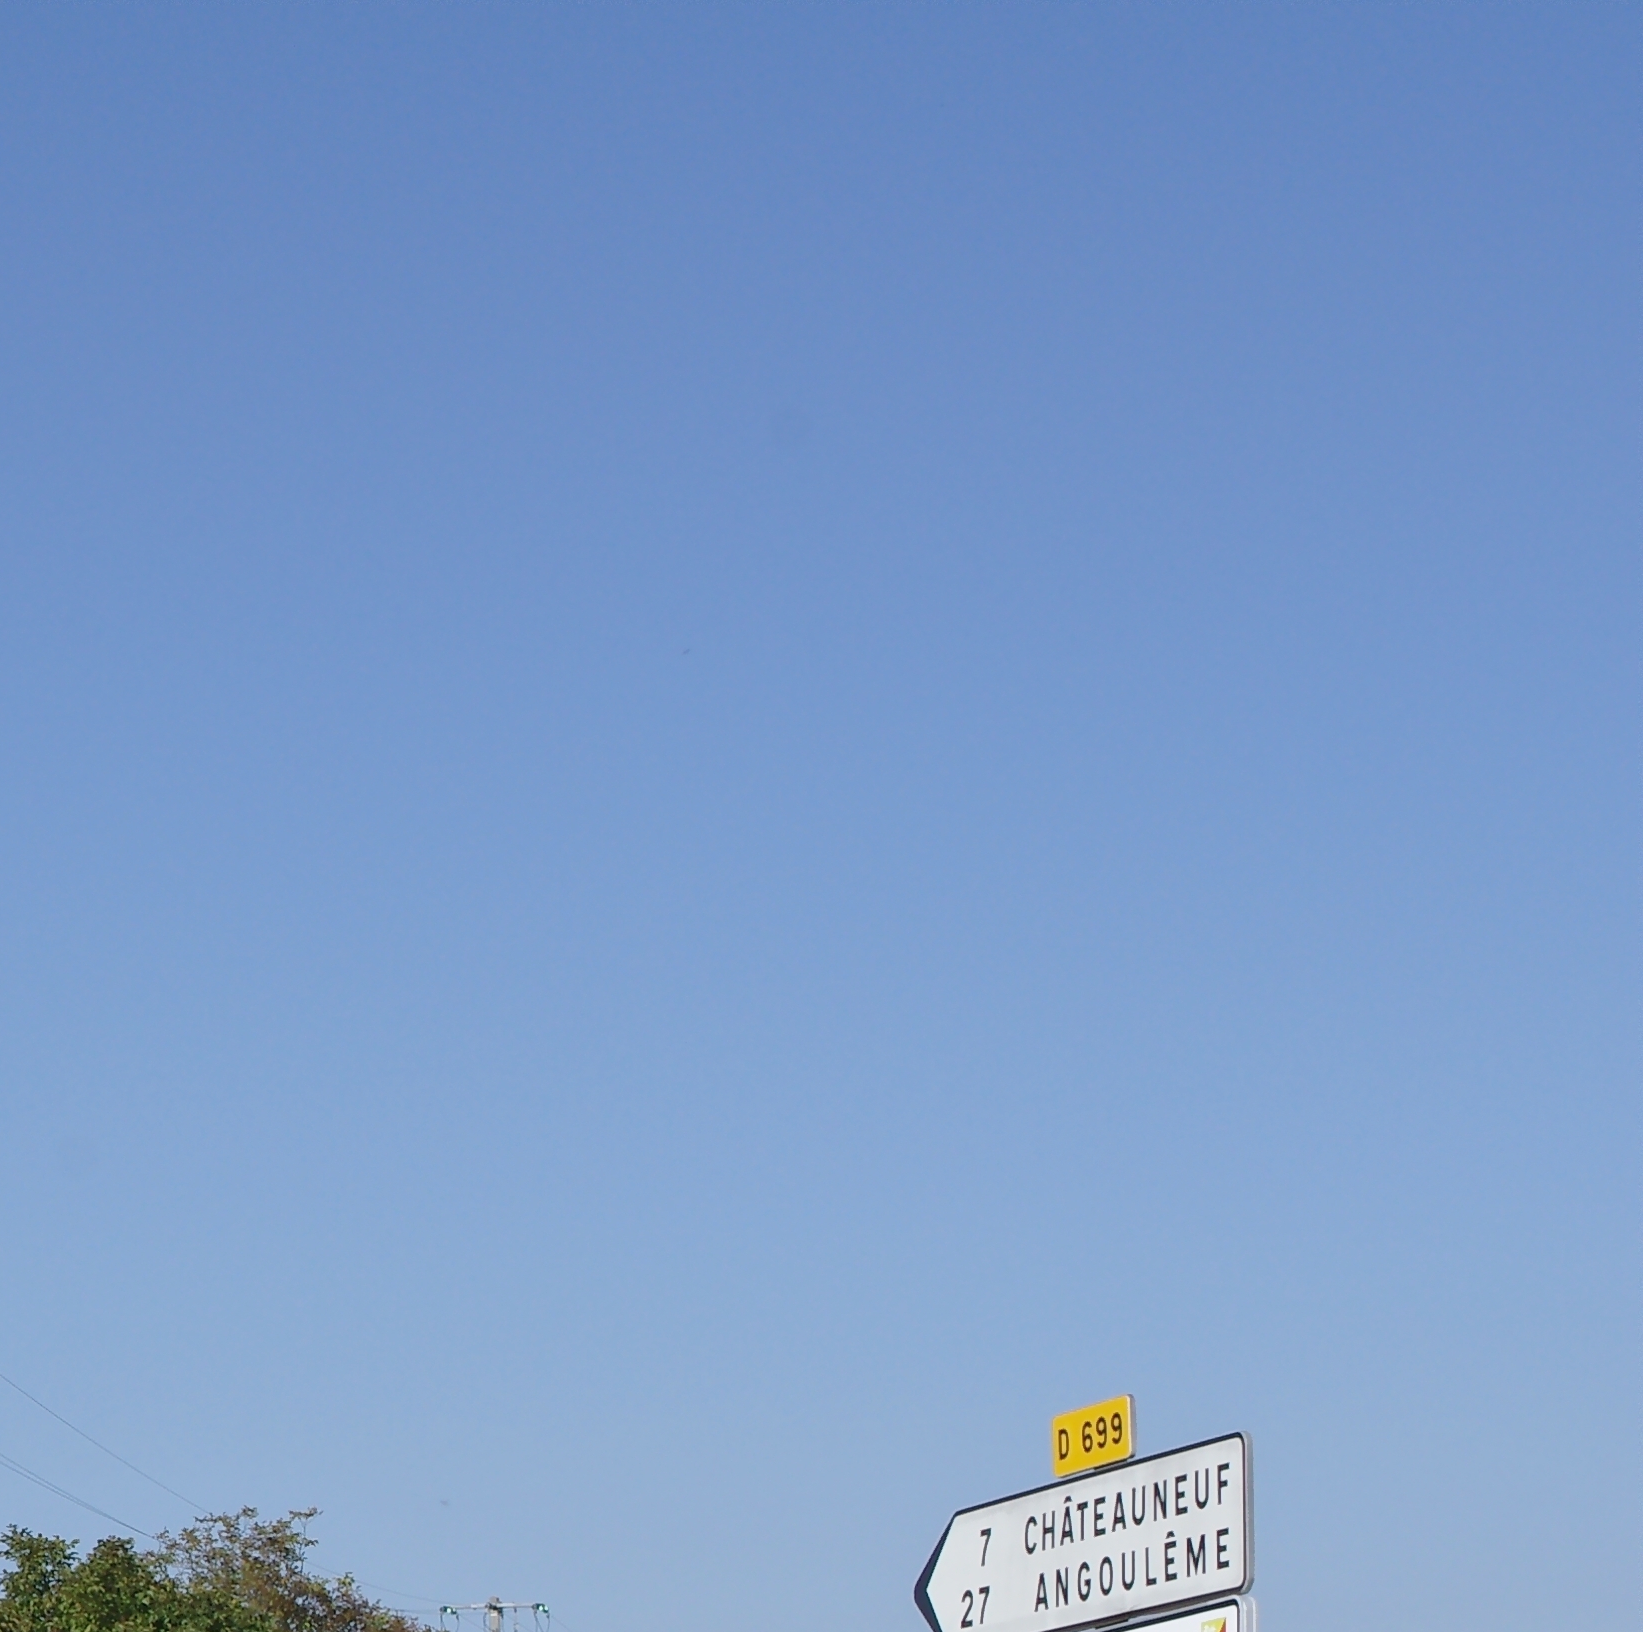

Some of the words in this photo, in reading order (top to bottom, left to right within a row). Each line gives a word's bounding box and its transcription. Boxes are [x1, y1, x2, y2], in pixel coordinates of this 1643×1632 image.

[1058, 1428, 1069, 1460] D
[1082, 1412, 1122, 1453] 699
[980, 1528, 991, 1567] 7
[1024, 1462, 1230, 1555] CHÂTEAUNEUF
[960, 1586, 990, 1629] 27
[1034, 1527, 1229, 1612] ANGOULÊME
